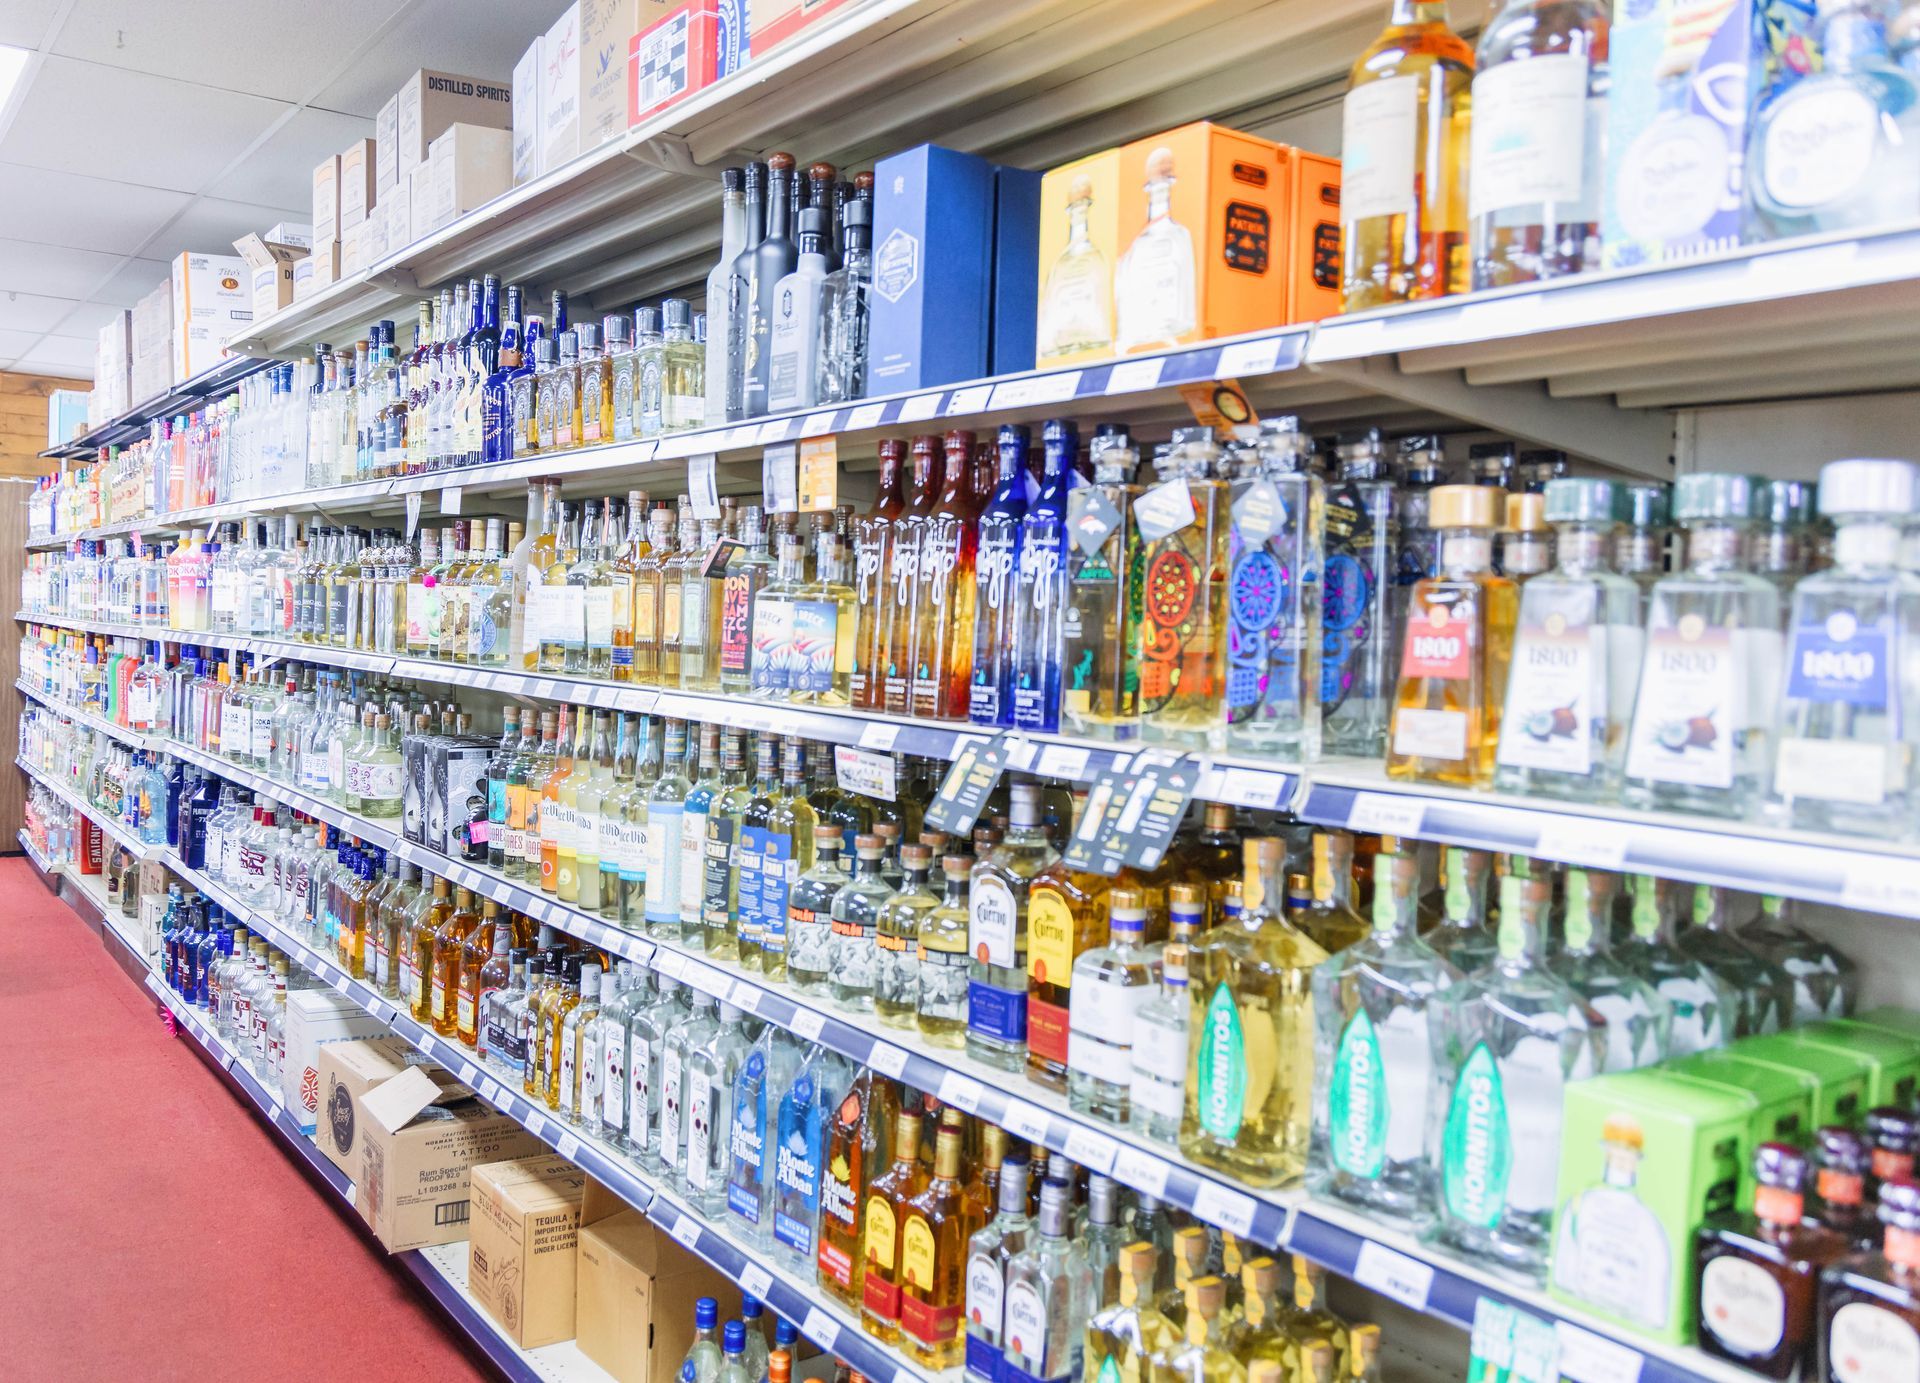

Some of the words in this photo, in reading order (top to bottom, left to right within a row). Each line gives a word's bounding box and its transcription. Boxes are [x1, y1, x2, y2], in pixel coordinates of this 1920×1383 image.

[428, 76, 473, 97] DISTILLED
[476, 84, 511, 103] SPIRITS
[218, 267, 241, 277] Tito's
[1413, 636, 1460, 659] 1800
[1528, 645, 1579, 669] 1800
[1661, 651, 1718, 674] 1800
[1802, 650, 1875, 681] 1800
[977, 902, 1006, 927] Cuervo
[1034, 917, 1065, 942] Cuervo
[1210, 1008, 1231, 1128] HORNITOS
[1348, 1038, 1370, 1168] HORNITOS
[425, 1137, 453, 1147] NORMAN
[442, 1130, 467, 1138] CRAFTED
[478, 1125, 499, 1133] HONOR
[732, 1120, 762, 1149] Monte
[433, 1143, 455, 1151] FATHER
[452, 1144, 501, 1158] TATTOO
[731, 1136, 761, 1168] Alban
[1463, 1074, 1492, 1216] HORNITOS
[420, 1169, 438, 1178] Rum
[439, 1164, 468, 1175] Special
[778, 1145, 815, 1178] Monte
[420, 1175, 445, 1184] PROOF
[446, 1171, 460, 1180] 92.0
[777, 1163, 813, 1197] Alban
[822, 1169, 857, 1206] Monte
[479, 1195, 494, 1213] BLUE
[493, 1210, 513, 1234] AGAVE
[821, 1188, 855, 1225] Alban
[534, 1225, 567, 1237] IMPORTED
[567, 1223, 573, 1231] &
[535, 1214, 568, 1227] TEQUILA
[783, 1216, 809, 1236] SILVER
[534, 1237, 548, 1246] JOSE
[550, 1232, 577, 1243] CUERVO,
[534, 1244, 555, 1255] UNDER
